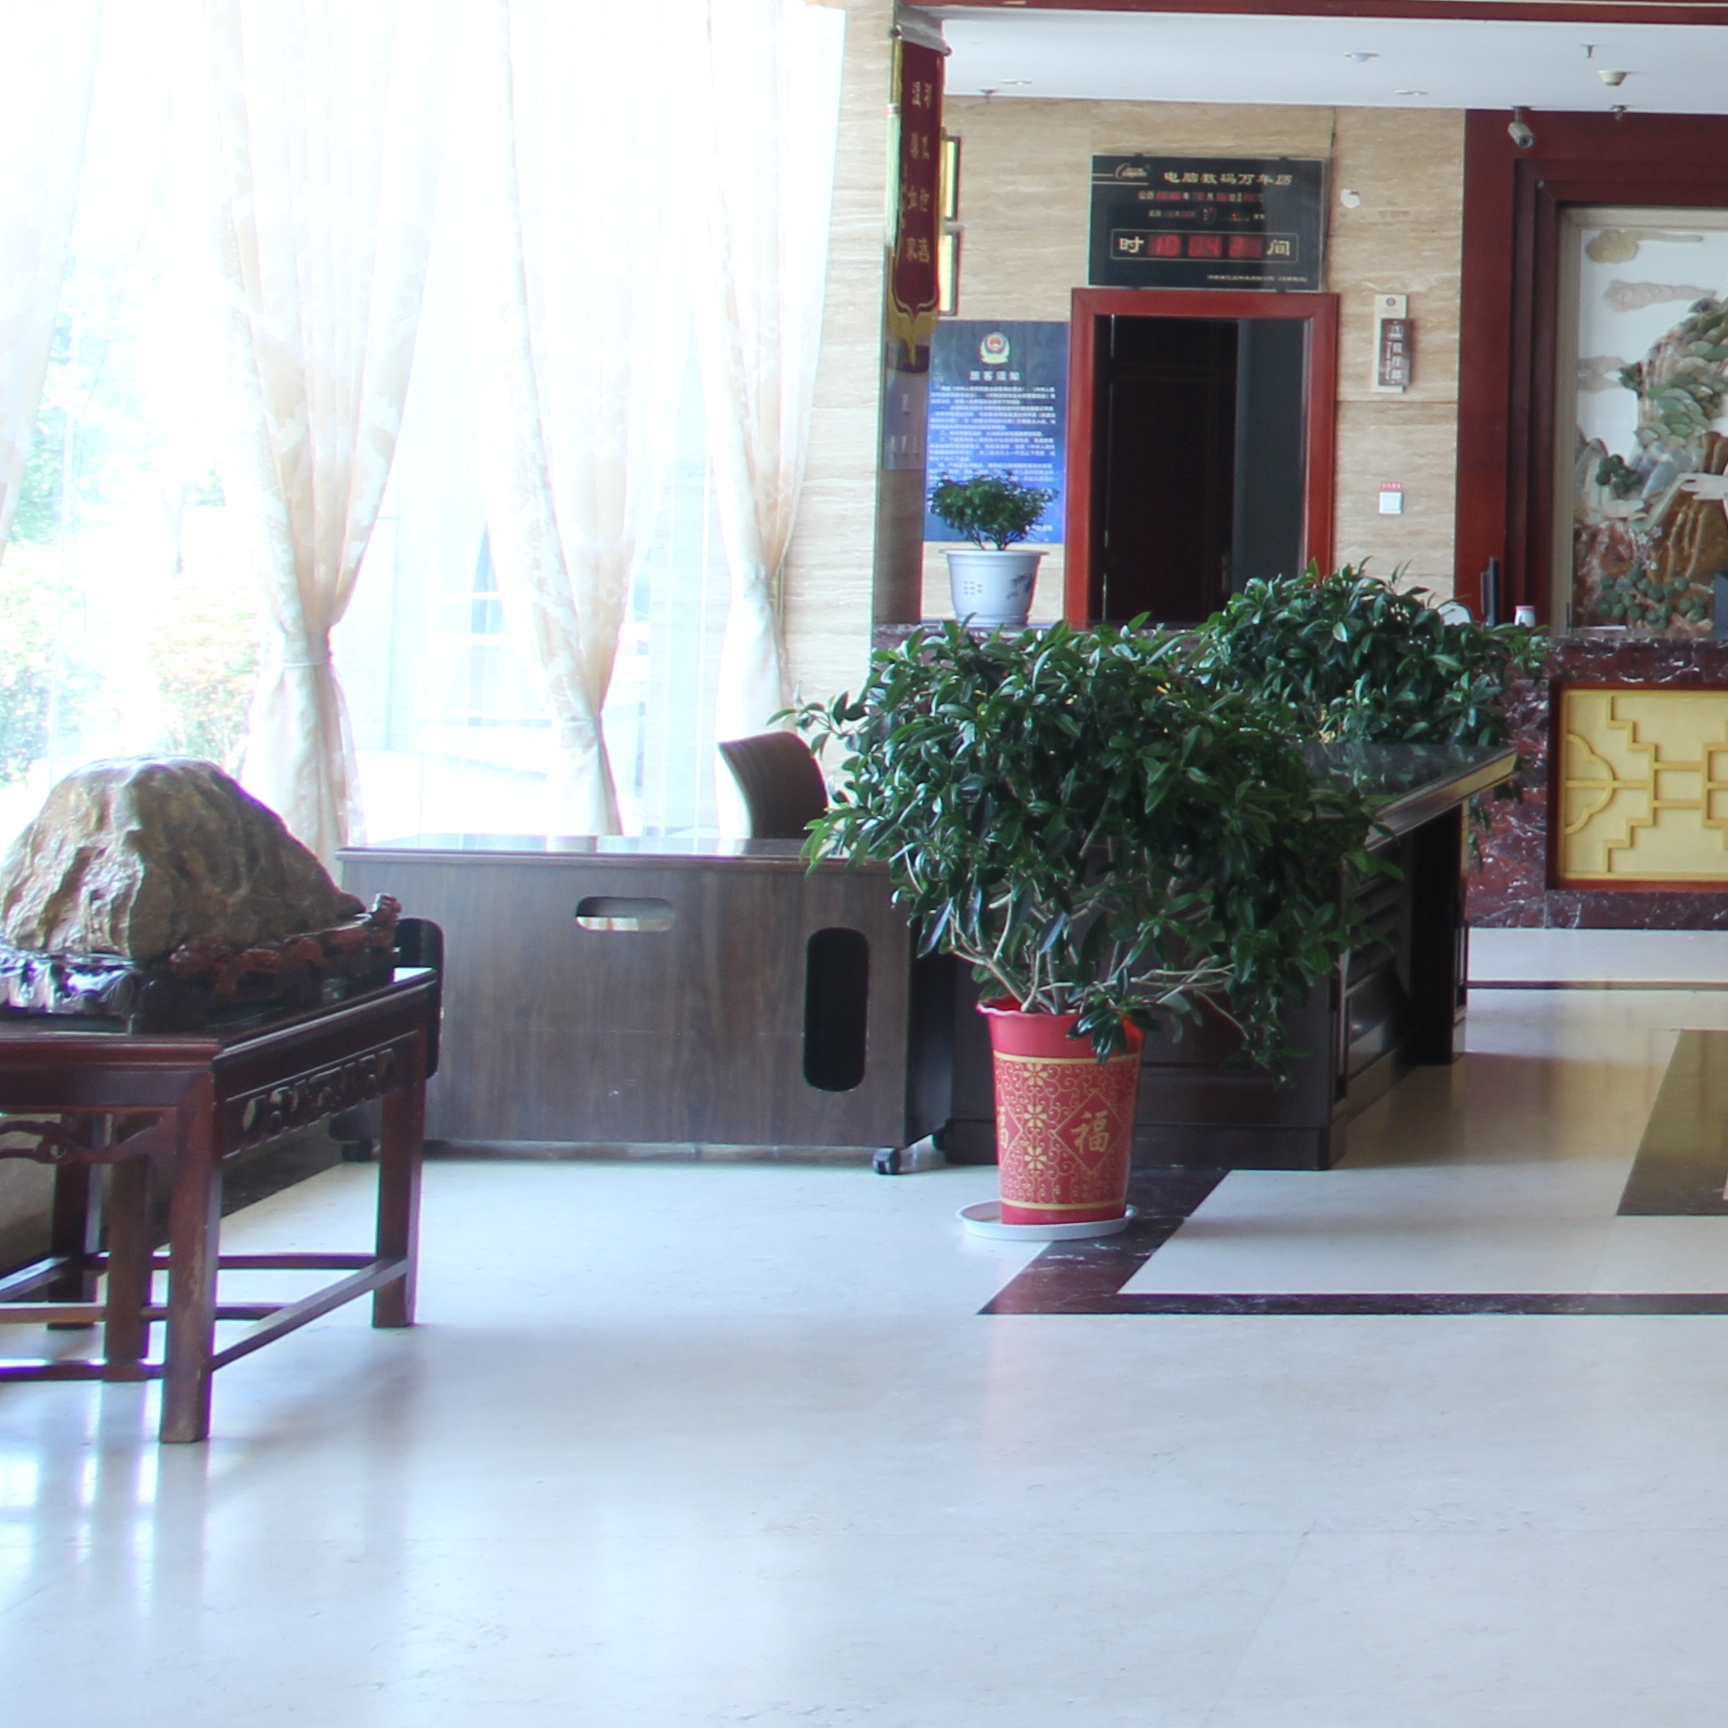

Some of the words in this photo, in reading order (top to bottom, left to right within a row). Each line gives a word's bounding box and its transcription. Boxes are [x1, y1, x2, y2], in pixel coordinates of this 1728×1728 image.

[1163, 171, 1293, 187] 电脑数码万年历
[1118, 235, 1144, 254] 时
[1266, 239, 1291, 257] 间
[1070, 1109, 1110, 1154] 福
